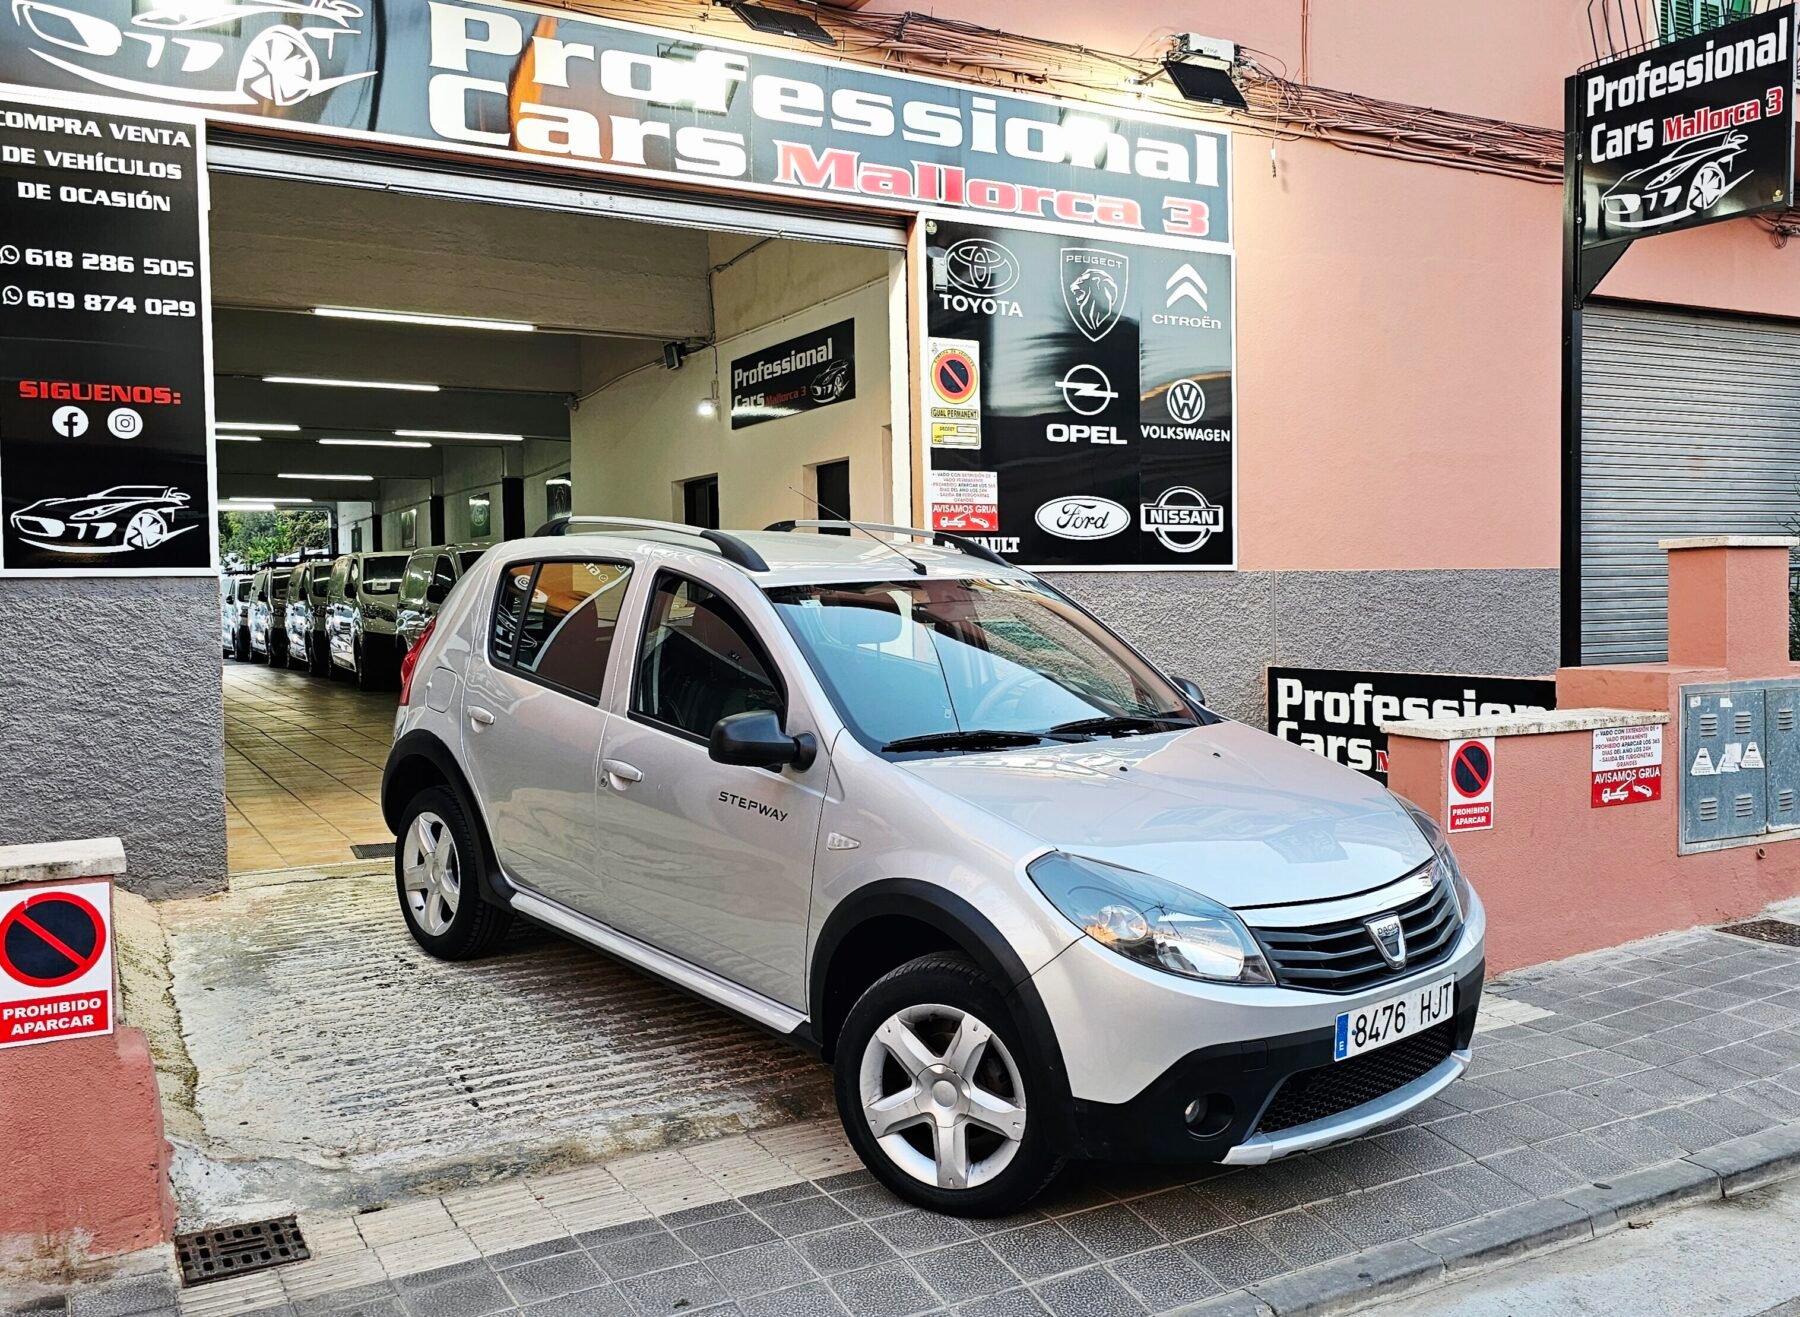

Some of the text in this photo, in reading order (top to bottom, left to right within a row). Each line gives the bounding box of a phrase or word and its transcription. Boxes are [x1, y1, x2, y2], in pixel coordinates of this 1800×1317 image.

[1587, 17, 1788, 117] Professional
[428, 1, 1219, 187] Professional
[109, 123, 191, 148] VENTA
[1591, 86, 1784, 164] Cars Mallorca 3
[2, 145, 182, 180] DE VEHÍCULOS
[429, 73, 1209, 236] Cars Mallorca 3
[18, 181, 170, 212] DE OCASIÓN
[25, 248, 194, 277] 618 286 505
[1066, 255, 1123, 269] PEUGEOT
[27, 290, 196, 317] 619 874 029
[939, 293, 1024, 318] TOYOTA
[734, 337, 833, 390] Professional
[19, 380, 182, 404] SIGUENOS:
[734, 392, 765, 408] Cars
[801, 386, 807, 397] 3
[1046, 423, 1128, 445] OPEL
[1140, 425, 1231, 443] VOLKSWAGEN
[932, 504, 998, 514] AVISAMOS GRUA
[1056, 502, 1110, 530] Ford
[1150, 508, 1214, 525] NISSAN
[1594, 766, 1661, 785] AVISAMOS GRUA
[718, 791, 788, 822] STEPWAY
[1452, 806, 1490, 816] PROHIBIDO
[1455, 816, 1487, 826] APARCAR
[1377, 922, 1400, 934] DACIA
[2, 997, 102, 1021] PROHIBIDO
[1355, 1000, 1406, 1048] 8476
[1420, 981, 1452, 1025] HJT
[11, 1014, 95, 1036] APARCAR
